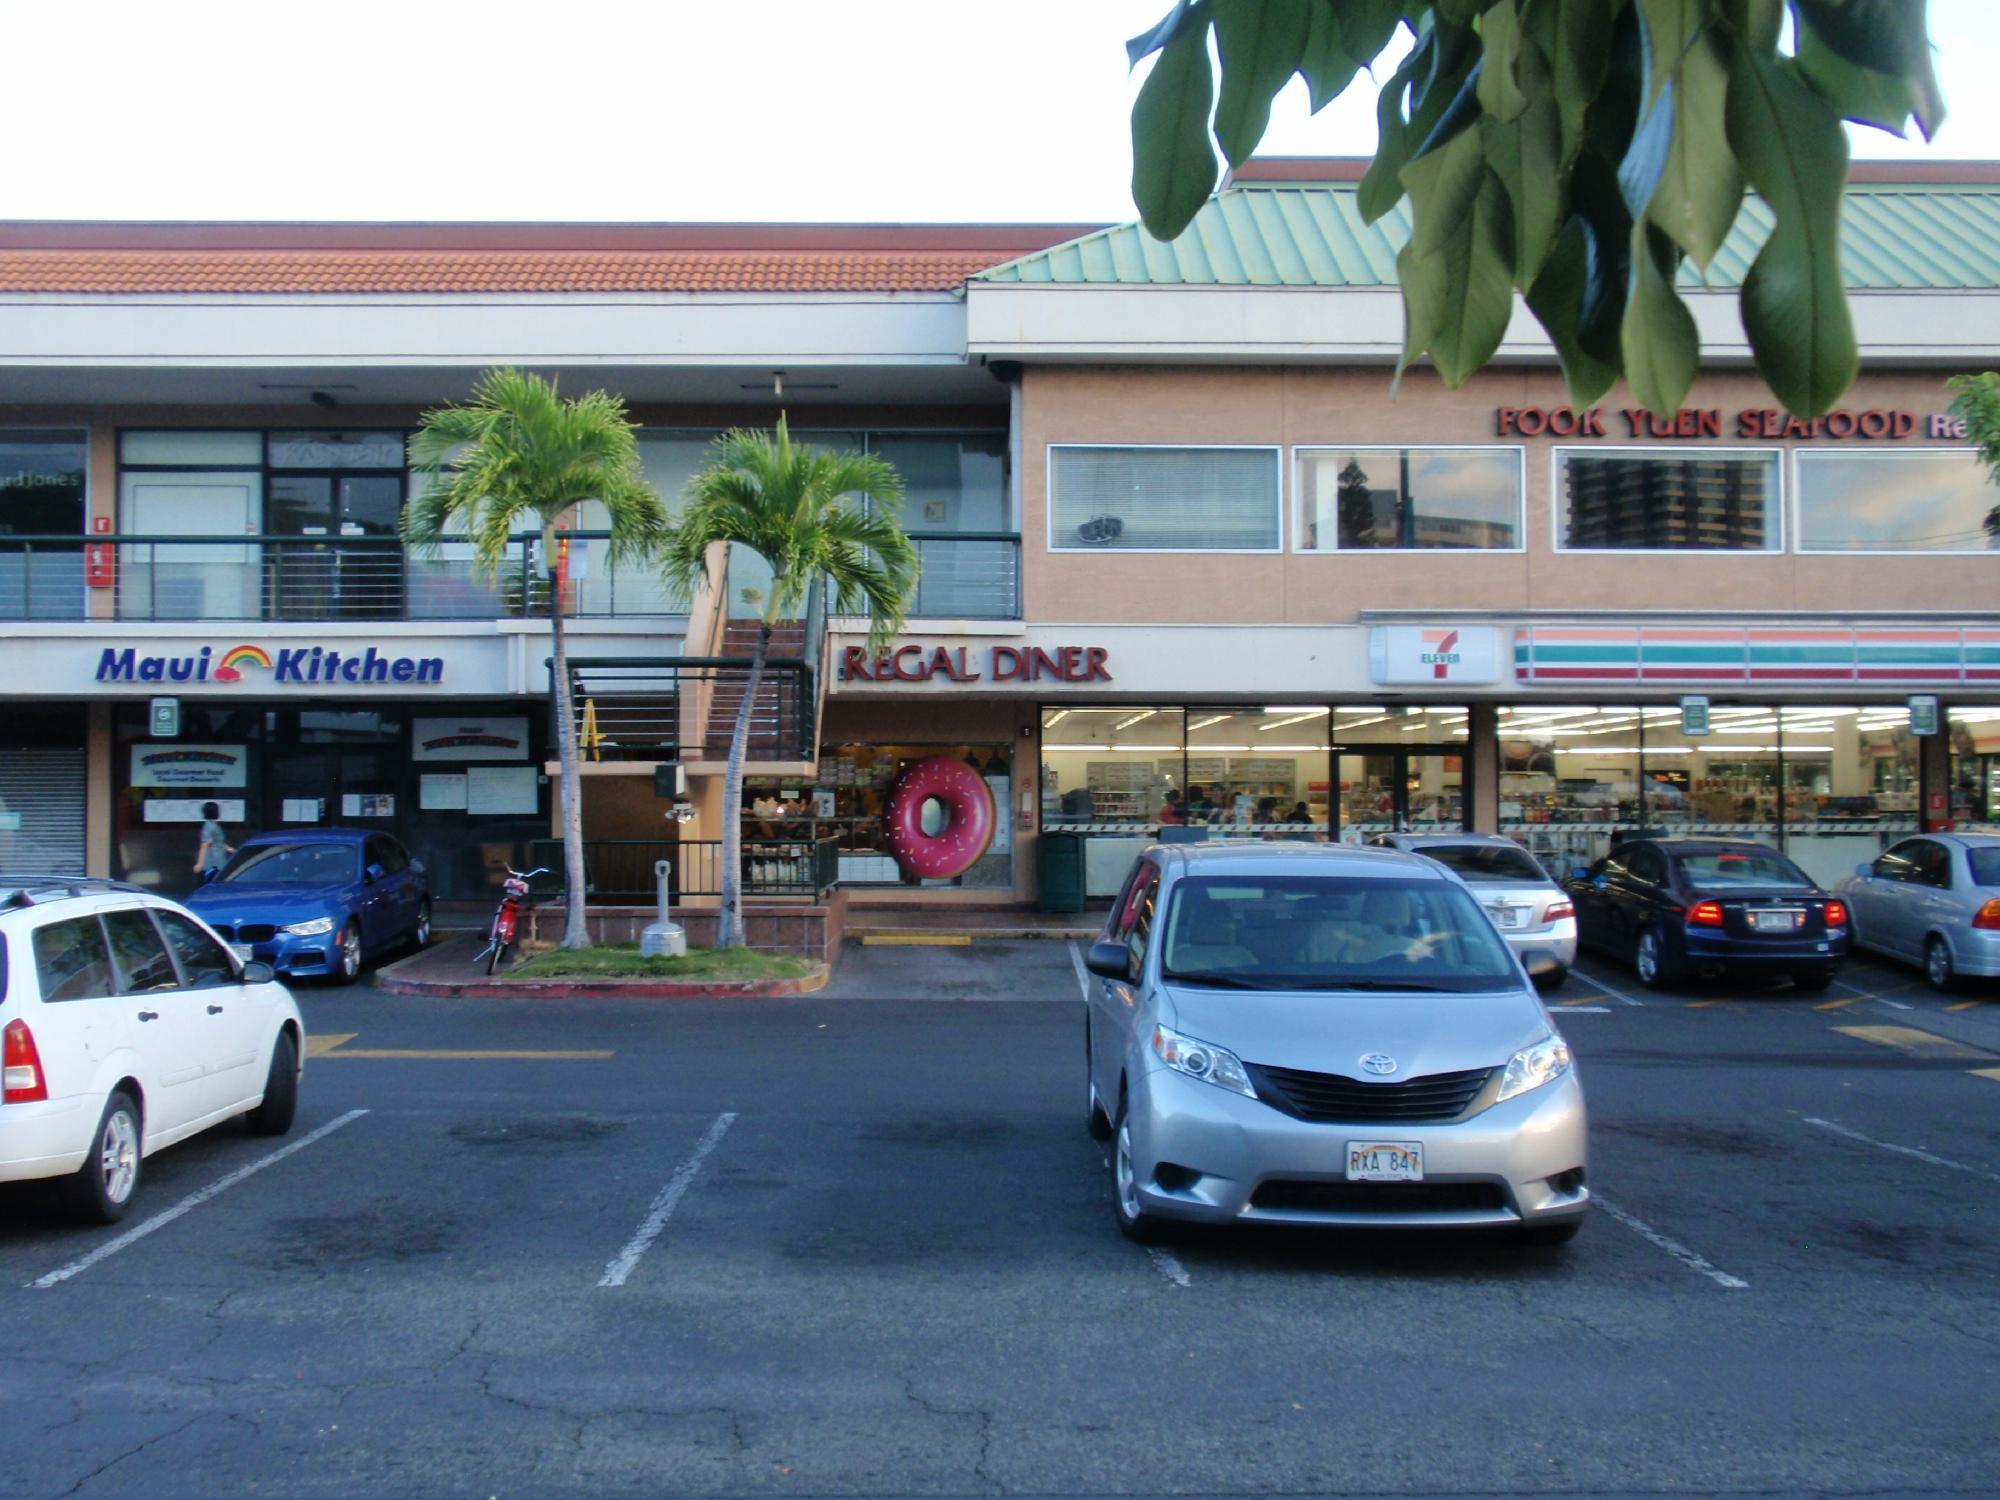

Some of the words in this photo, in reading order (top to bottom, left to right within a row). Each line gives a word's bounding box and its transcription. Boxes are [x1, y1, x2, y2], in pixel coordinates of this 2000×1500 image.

[1497, 405, 1606, 437] FOOK
[1623, 407, 1721, 438] YUEN
[1737, 407, 1917, 439] SEAFOOD
[1928, 412, 1968, 438] Re
[95, 646, 212, 681] Maui
[274, 646, 444, 682] Kitchen
[844, 645, 980, 682] REGAL
[991, 645, 1112, 682] DINER
[1351, 1151, 1380, 1171] RXA
[1390, 1151, 1418, 1171] 847
